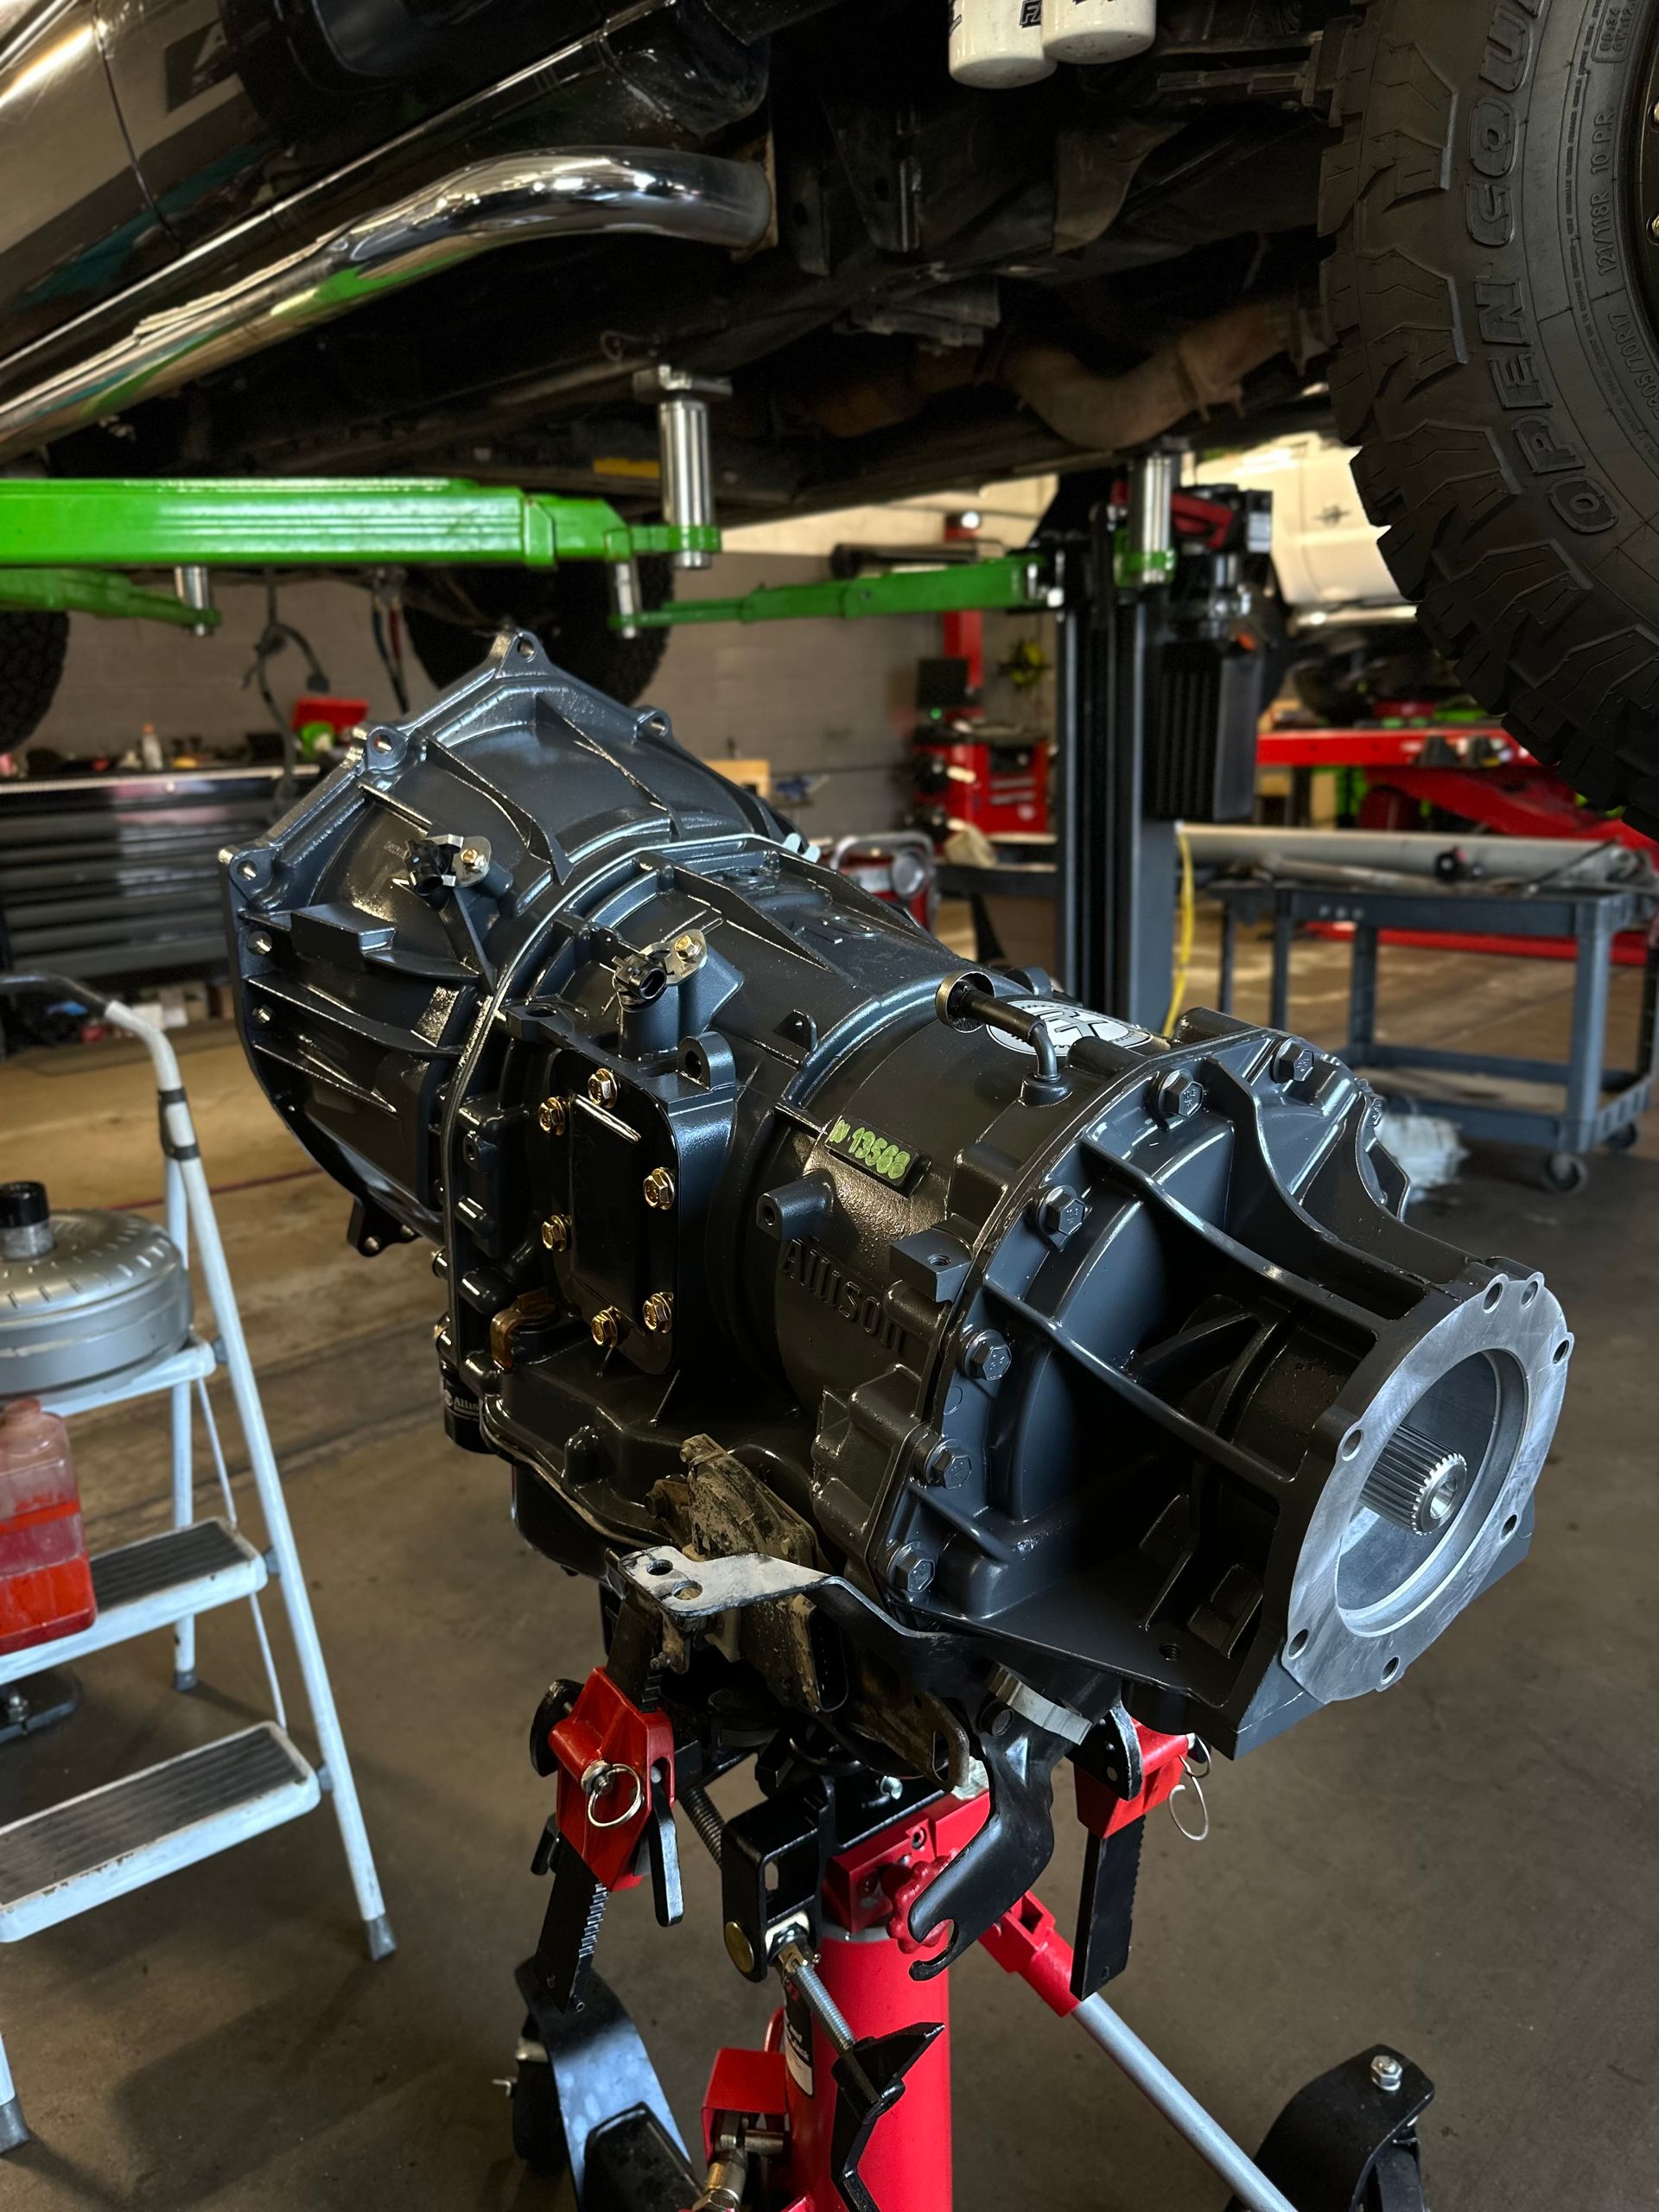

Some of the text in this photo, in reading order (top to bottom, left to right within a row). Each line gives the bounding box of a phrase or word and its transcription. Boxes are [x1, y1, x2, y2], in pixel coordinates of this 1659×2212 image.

[1591, 154, 1611, 175] 10
[1465, 0, 1618, 532] OPEN COU
[1591, 192, 1617, 276] 121/118R
